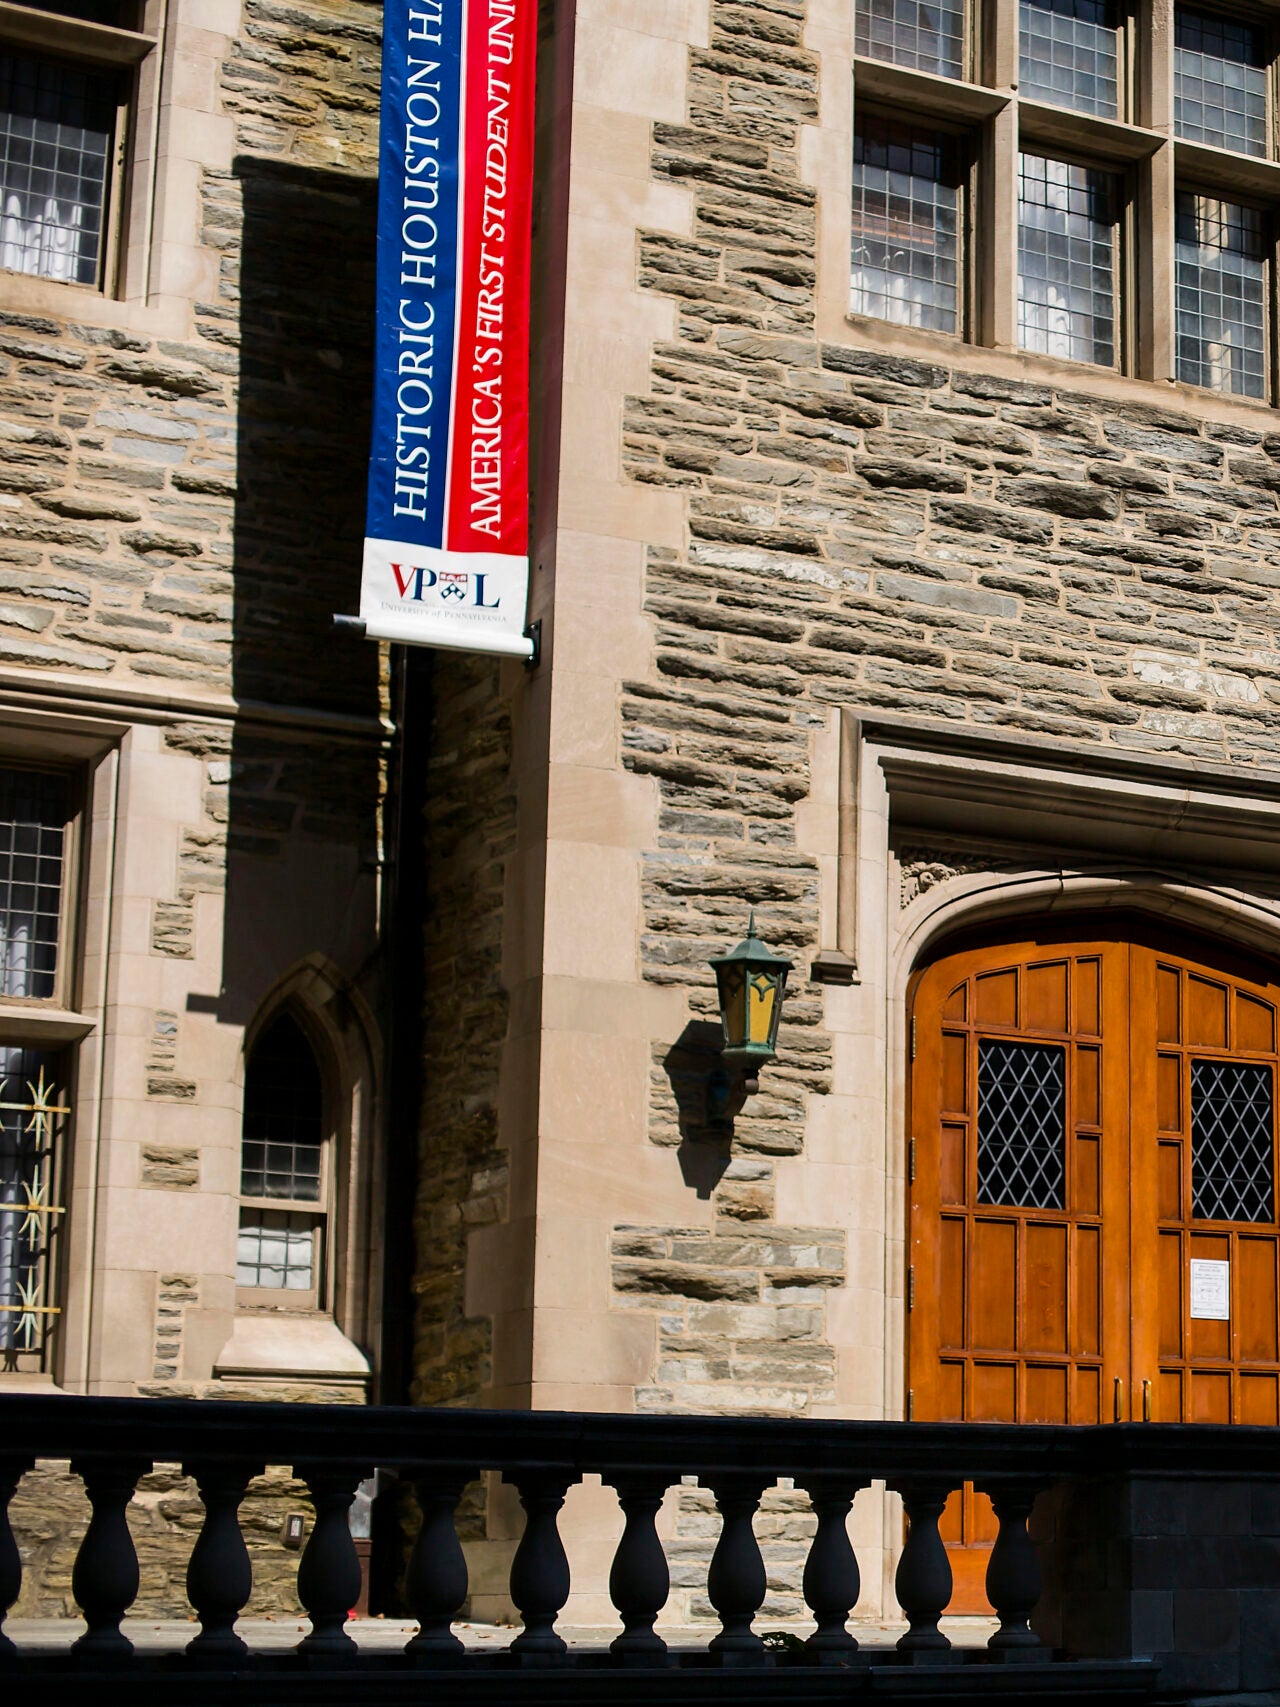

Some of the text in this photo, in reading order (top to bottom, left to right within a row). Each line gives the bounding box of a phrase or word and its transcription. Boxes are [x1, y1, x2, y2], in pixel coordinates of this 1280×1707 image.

[400, 54, 441, 289] HOUSTON
[470, 0, 516, 540] AMERICA'S FIRST STUDENT UNI
[393, 299, 435, 522] HISTORIC
